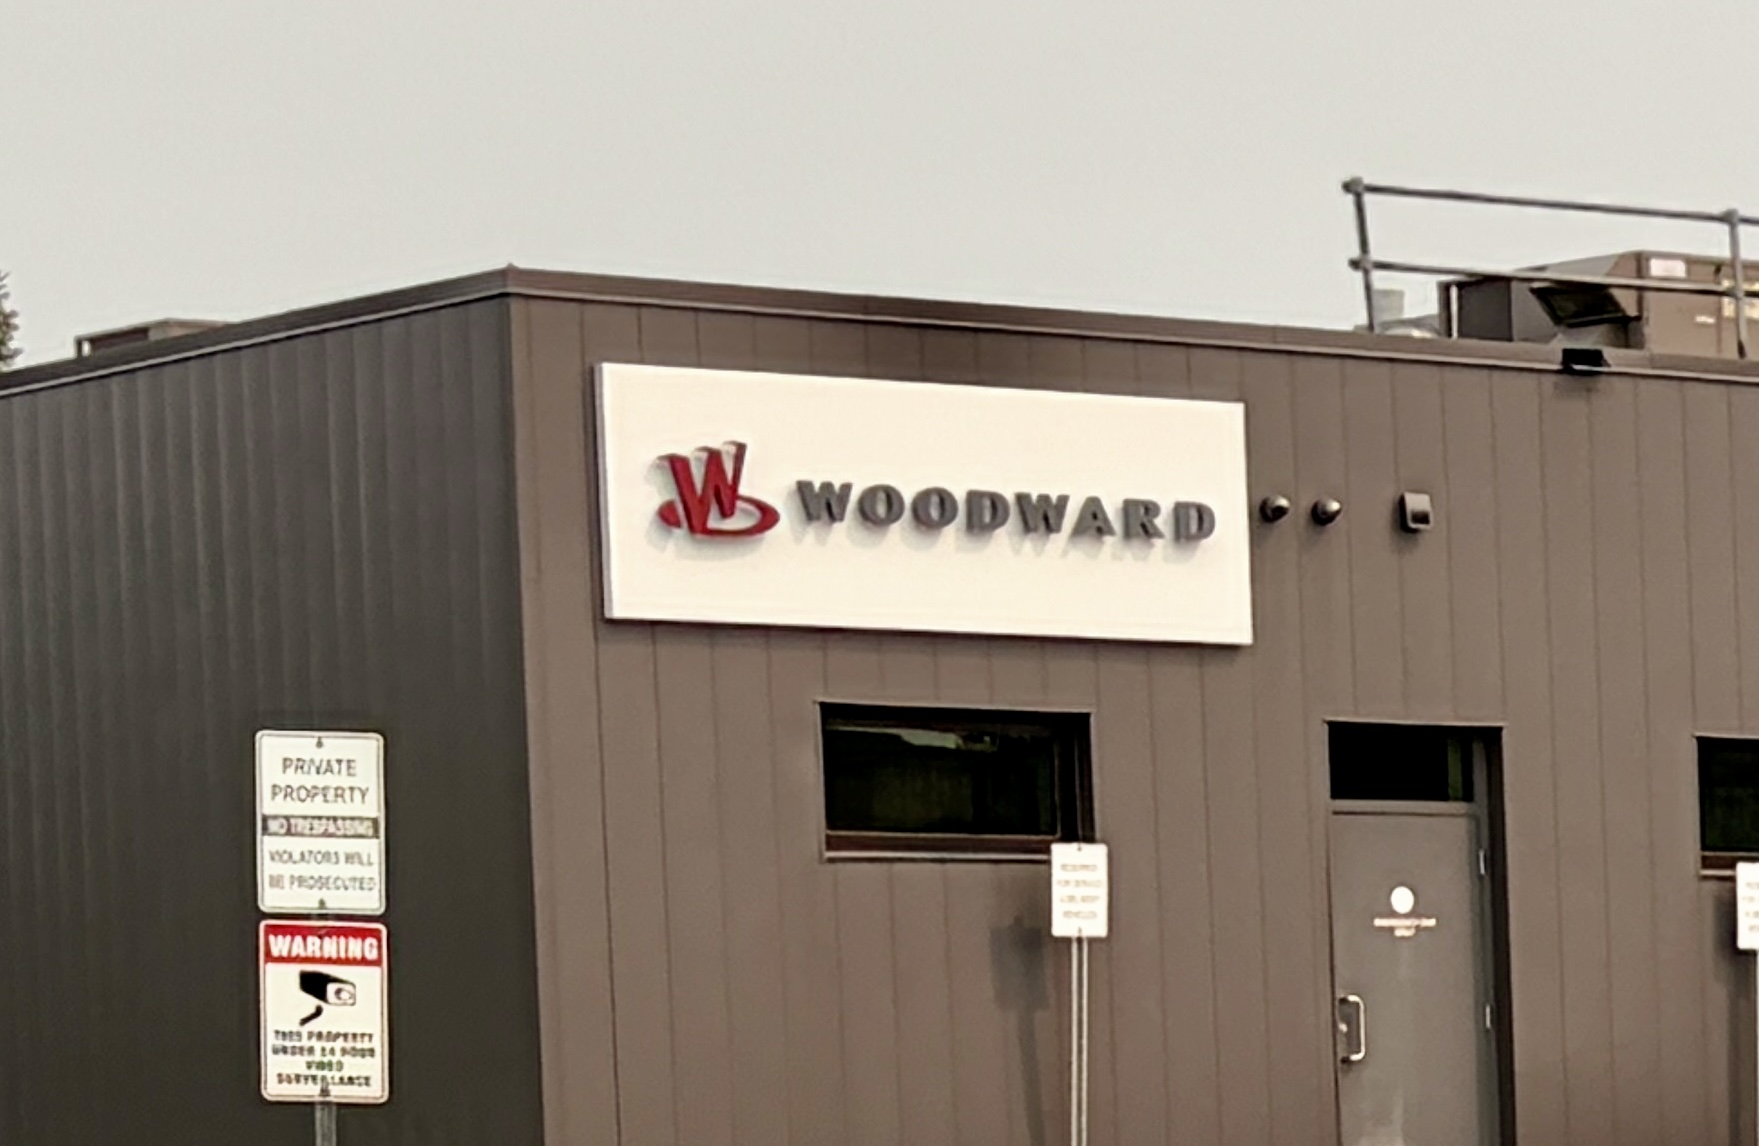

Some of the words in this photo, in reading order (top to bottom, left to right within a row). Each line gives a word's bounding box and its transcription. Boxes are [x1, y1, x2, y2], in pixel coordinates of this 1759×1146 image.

[795, 480, 1216, 543] WOODWARD
[282, 757, 357, 777] PRIVATE
[271, 784, 369, 805] PROPERTY
[267, 817, 289, 835] NO
[268, 849, 340, 865] VIOLATORS
[344, 851, 375, 867] WILL
[268, 874, 285, 890] BE
[289, 874, 377, 892] PROSECUTED
[268, 934, 379, 960] WARNING
[307, 1031, 374, 1043] PROPERTY
